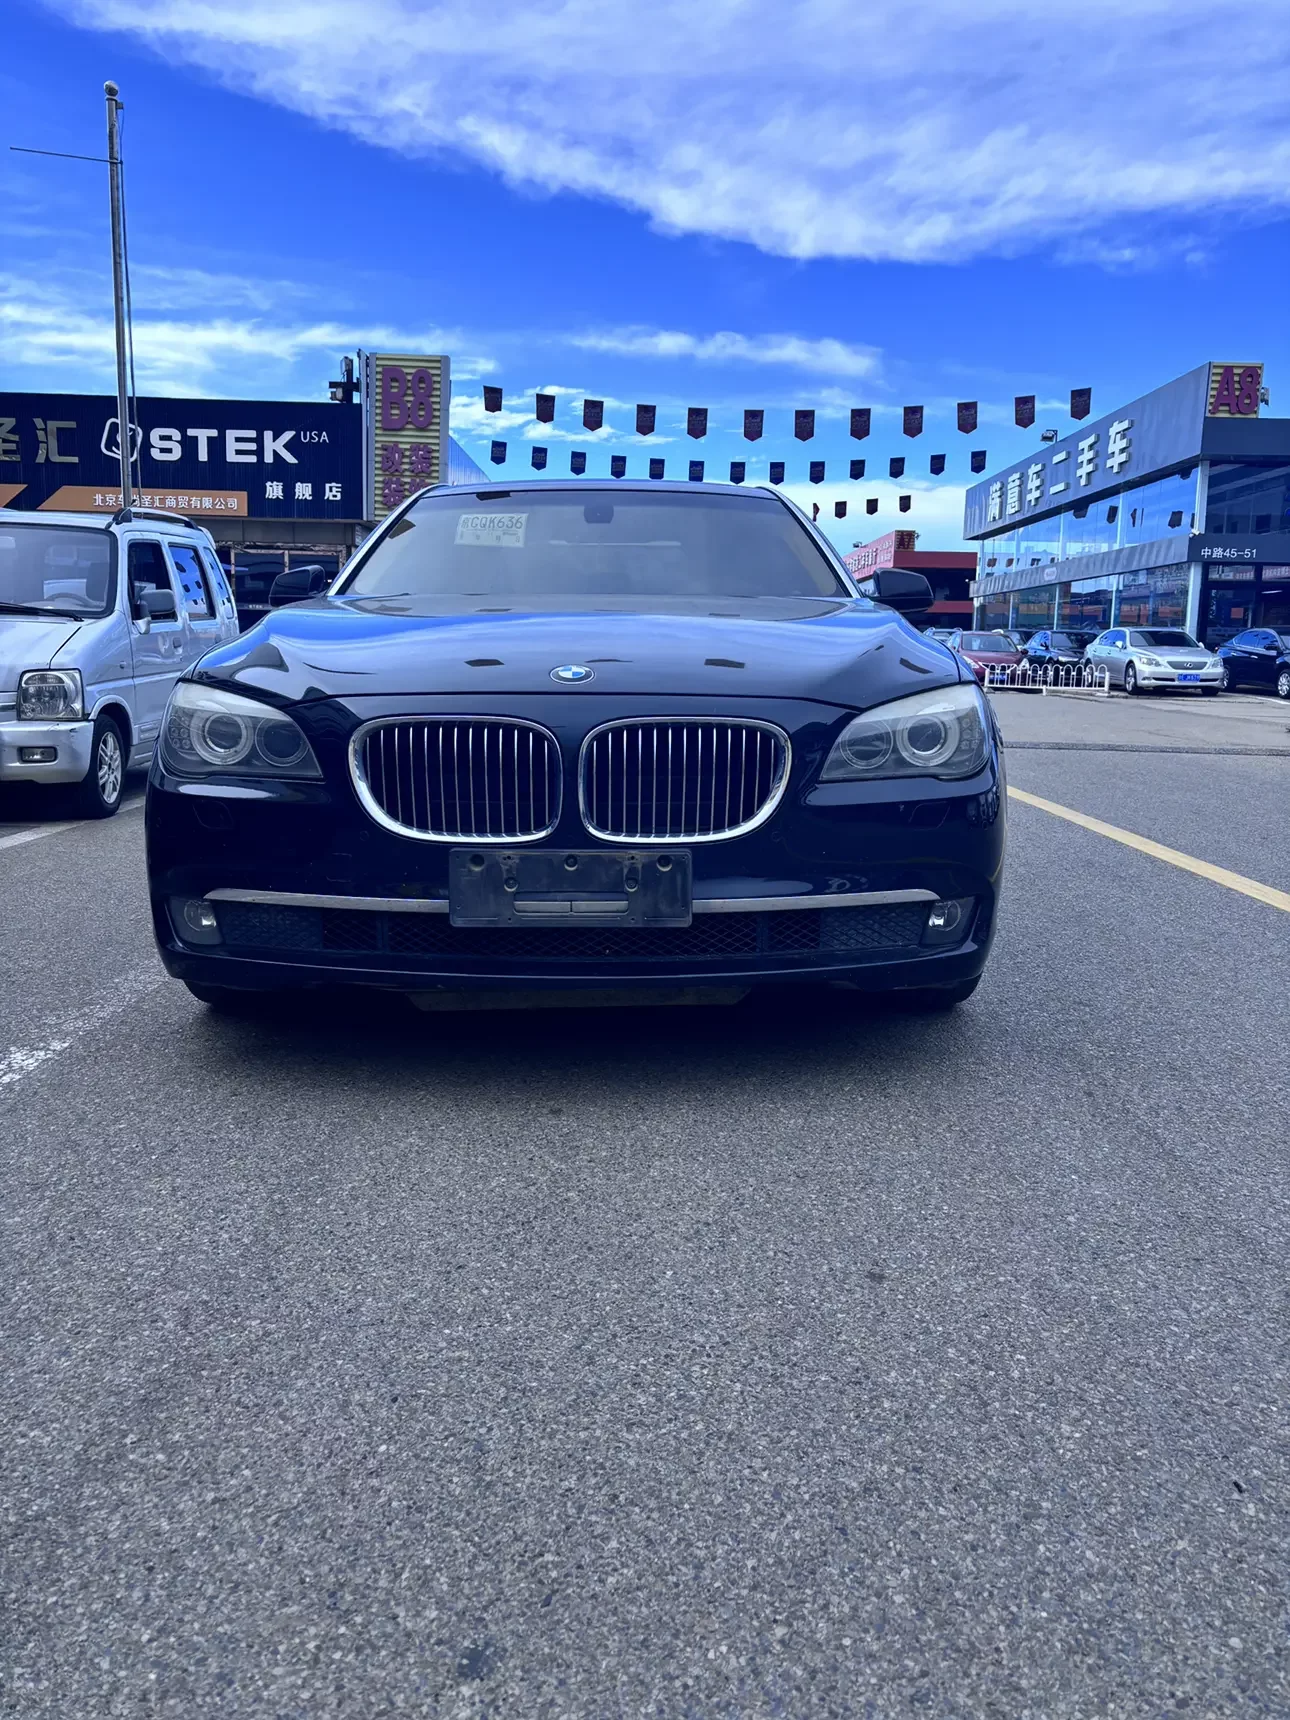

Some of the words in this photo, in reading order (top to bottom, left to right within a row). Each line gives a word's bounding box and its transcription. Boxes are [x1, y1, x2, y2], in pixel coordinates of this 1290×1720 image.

[381, 366, 434, 431] B8
[1209, 366, 1260, 415] A8
[149, 426, 299, 464] STEK
[300, 430, 329, 443] USA
[380, 442, 434, 475] 改装
[987, 417, 1134, 522] 满意车二手车
[265, 481, 342, 500] 旗舰店
[1201, 547, 1257, 558] 中路45-51
